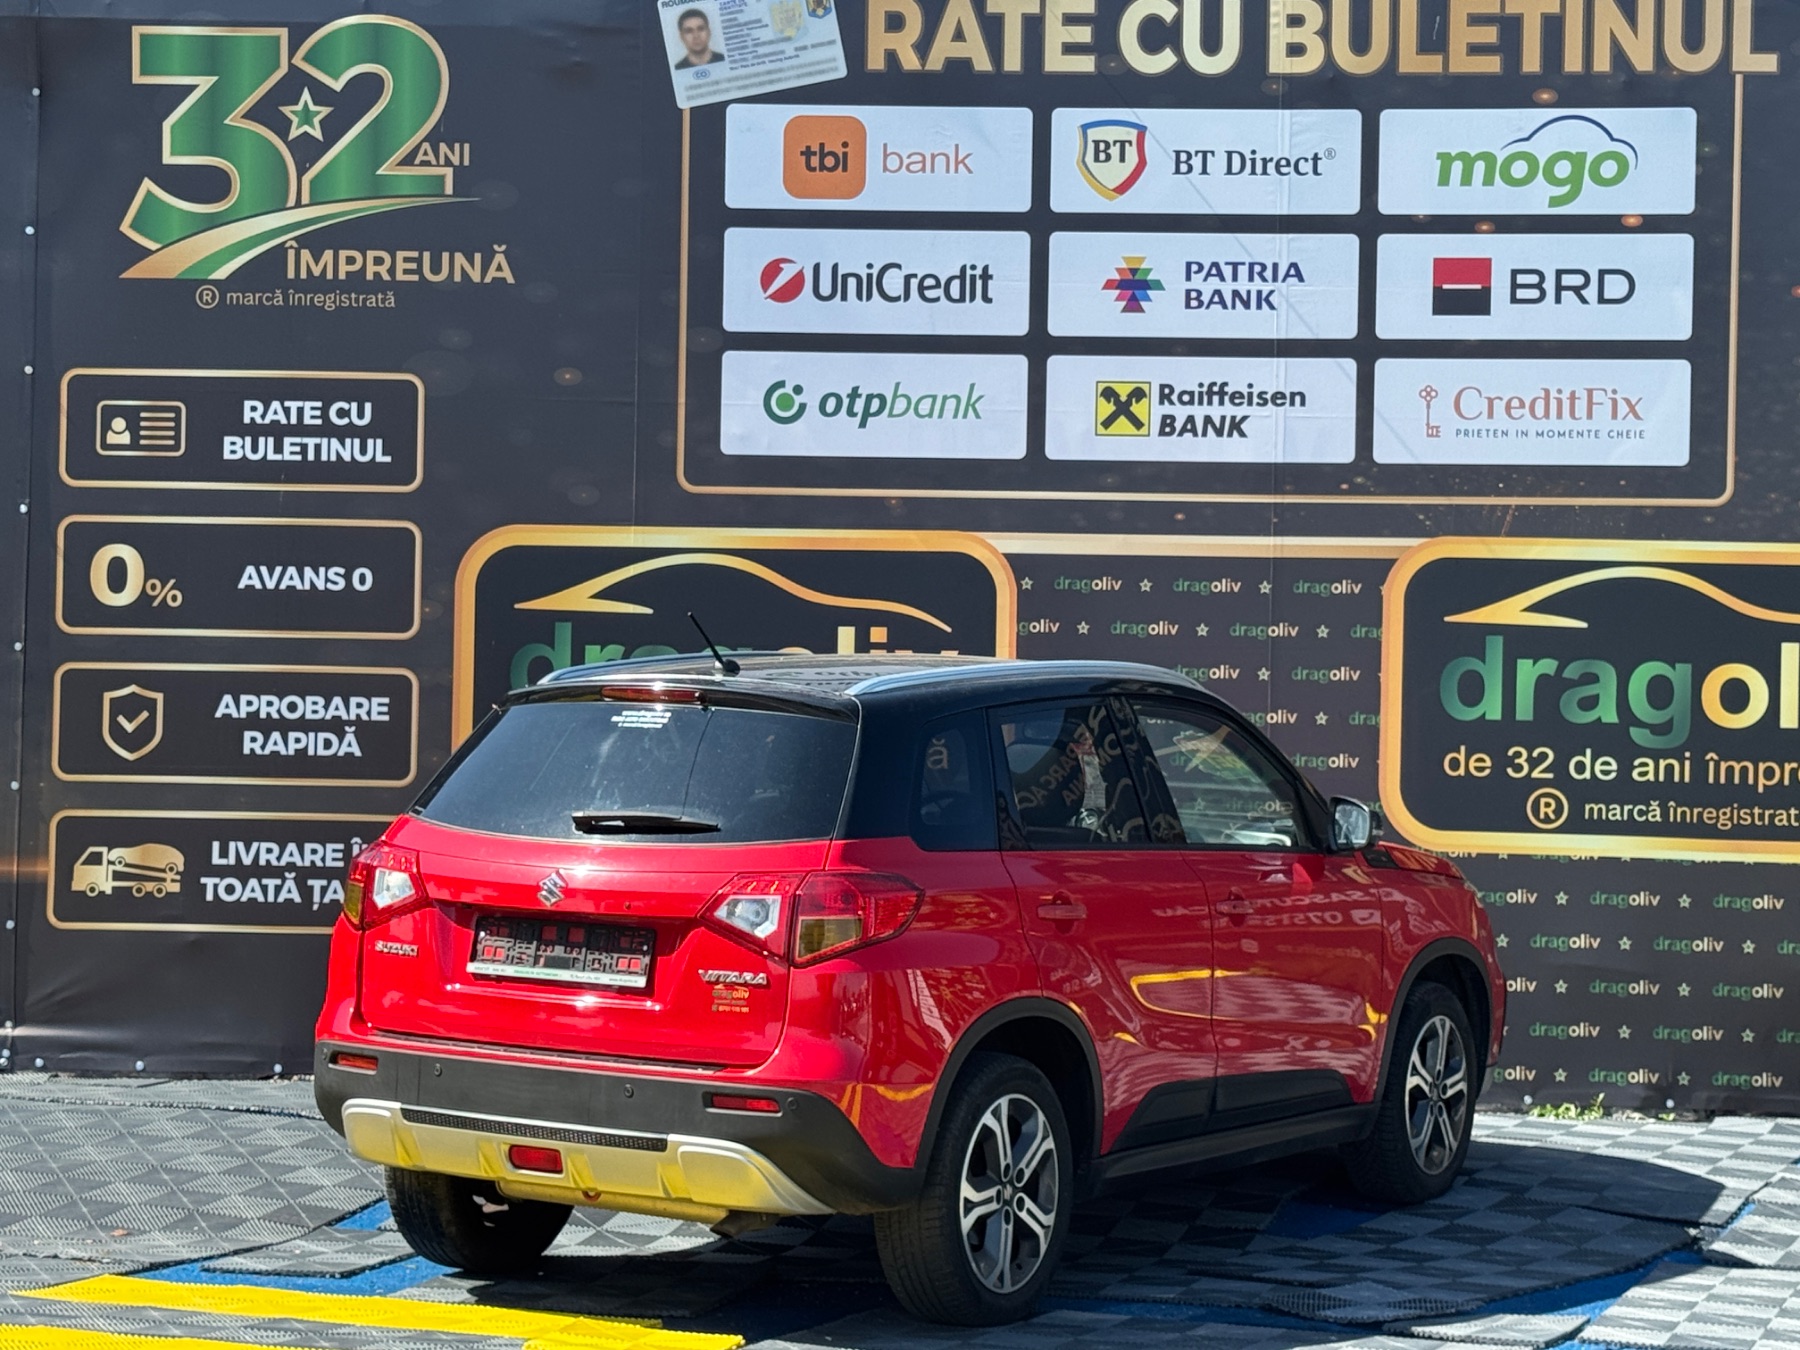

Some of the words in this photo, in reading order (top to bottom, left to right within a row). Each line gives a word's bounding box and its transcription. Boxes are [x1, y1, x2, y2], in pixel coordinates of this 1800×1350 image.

[863, 0, 1098, 74] RATE
[1116, 0, 1242, 75] CU
[1266, 0, 1780, 75] BULETINUL
[119, 14, 453, 251] 32
[413, 142, 470, 166] ANI
[800, 141, 849, 172] tbi
[883, 143, 973, 174] bank
[1092, 140, 1132, 163] BT
[1172, 150, 1215, 175] BT
[1436, 148, 1632, 208] mogo
[284, 241, 515, 283] ÎMPREUNĂ
[1185, 261, 1305, 283] PATRIA
[812, 262, 993, 304] UniCredit
[1510, 269, 1636, 305] BRD
[227, 289, 284, 305] marcă
[288, 289, 395, 311] înregistrată
[1185, 289, 1277, 310] BANK
[819, 382, 984, 429] otpbank
[1159, 381, 1306, 407] Raiffeisen
[1453, 387, 1643, 420] CreditFix
[244, 400, 322, 425] RATE
[329, 401, 372, 426] CU
[1158, 414, 1250, 438] BANK
[1456, 429, 1508, 438] PRIETEN
[1516, 430, 1528, 438] IN
[1536, 429, 1600, 439] MOMENTE
[1607, 429, 1645, 439] CHEIE
[223, 436, 391, 462] BULETINUL
[90, 544, 182, 607] 0%
[238, 565, 345, 591] AVANS
[352, 567, 373, 591] 0
[1055, 577, 1122, 592] dragoliv
[1174, 578, 1241, 594] dragoliv
[1294, 580, 1362, 596] dragoliv
[1019, 619, 1059, 635] goliv
[1112, 621, 1178, 637] dragoliv
[1230, 623, 1299, 639] dragoliv
[1293, 667, 1360, 683] dragoliv
[1440, 635, 1799, 749] dragol
[215, 694, 389, 721] APROBARE
[1247, 709, 1298, 727] agoliv
[243, 726, 362, 756] RAPIDĂ
[1444, 745, 1492, 777] de
[1506, 746, 1554, 778] 32
[1569, 748, 1617, 780] de
[1632, 752, 1690, 783] ani
[1585, 801, 1662, 822] marcă
[212, 841, 344, 867] LIVRARE
[200, 872, 301, 903] TOATĂ
[306, 878, 345, 911] ȚA
[1480, 889, 1538, 907] ragoliv
[1591, 891, 1660, 908] dragoliv
[1714, 895, 1784, 911] dragoliv
[1531, 934, 1600, 951] dragoliv
[1654, 937, 1724, 953] dragoliv
[698, 969, 767, 984] VITARA
[1506, 977, 1537, 992] oliv
[1590, 980, 1660, 996] dragoliv
[1713, 983, 1784, 1000] dragoliv
[1530, 1022, 1600, 1039] dragoliv
[1654, 1026, 1723, 1042] dragoliv
[1493, 1065, 1537, 1084] goliv
[1589, 1069, 1659, 1086] dragoliv
[1713, 1072, 1783, 1087] dragoliv
